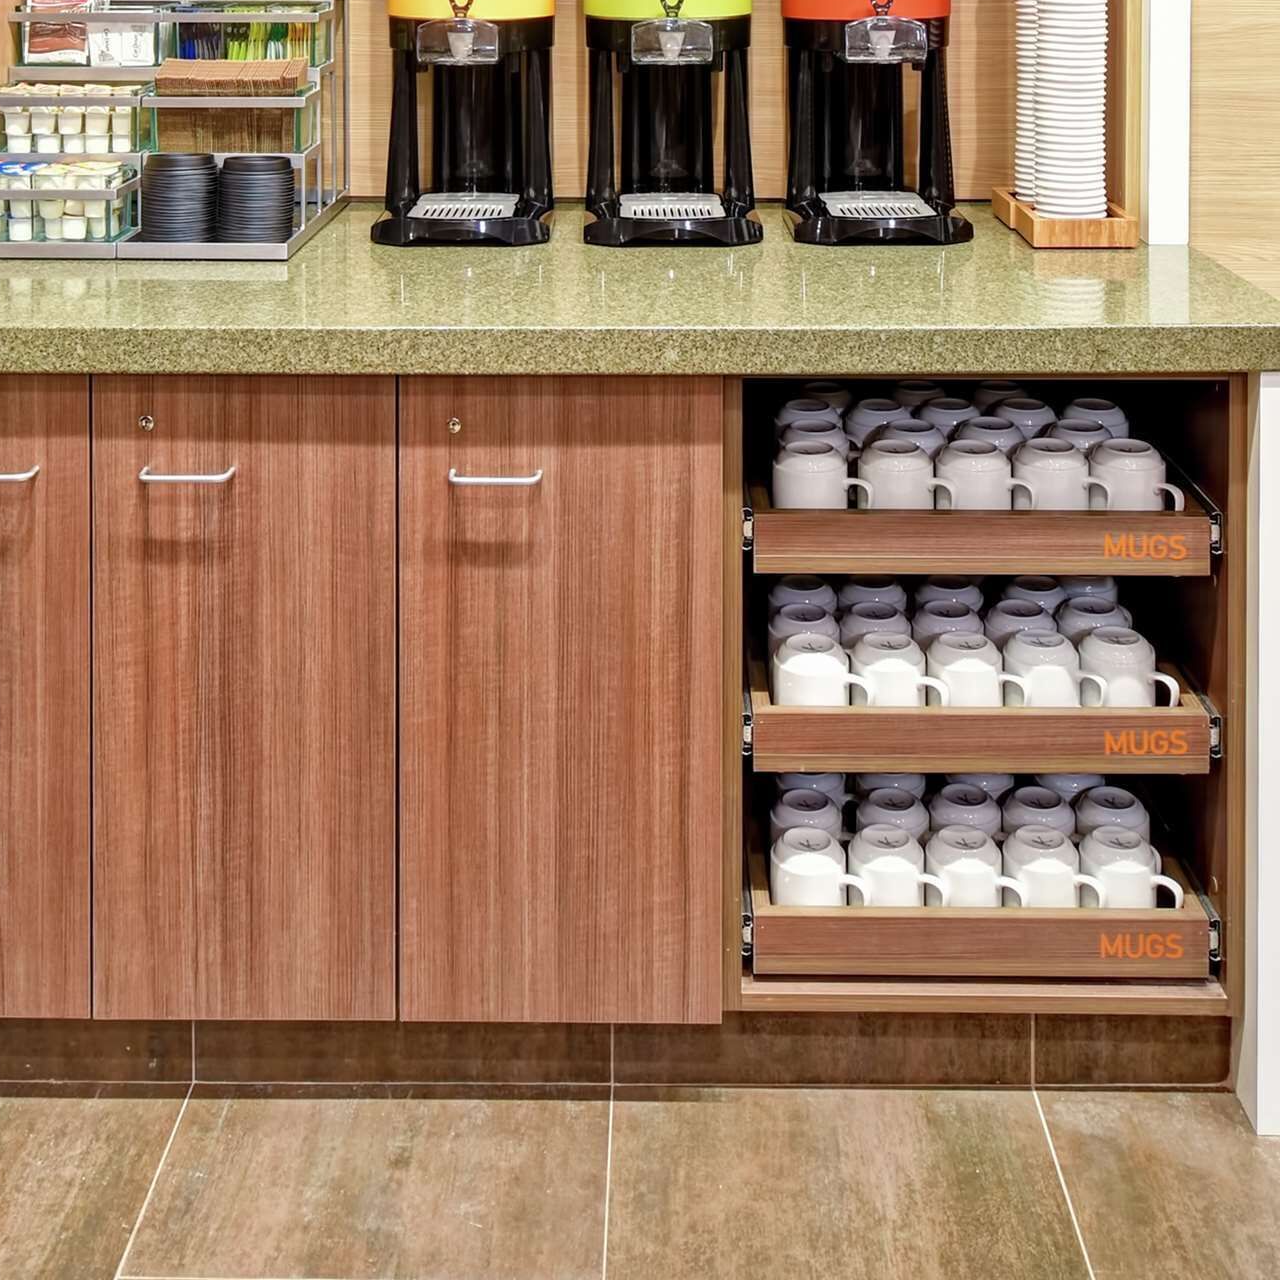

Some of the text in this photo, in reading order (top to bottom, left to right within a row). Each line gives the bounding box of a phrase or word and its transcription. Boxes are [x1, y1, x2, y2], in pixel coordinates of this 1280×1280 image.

[1103, 532, 1187, 560] MUGS
[1103, 729, 1188, 755] MUGS
[1100, 932, 1185, 959] MUGS
